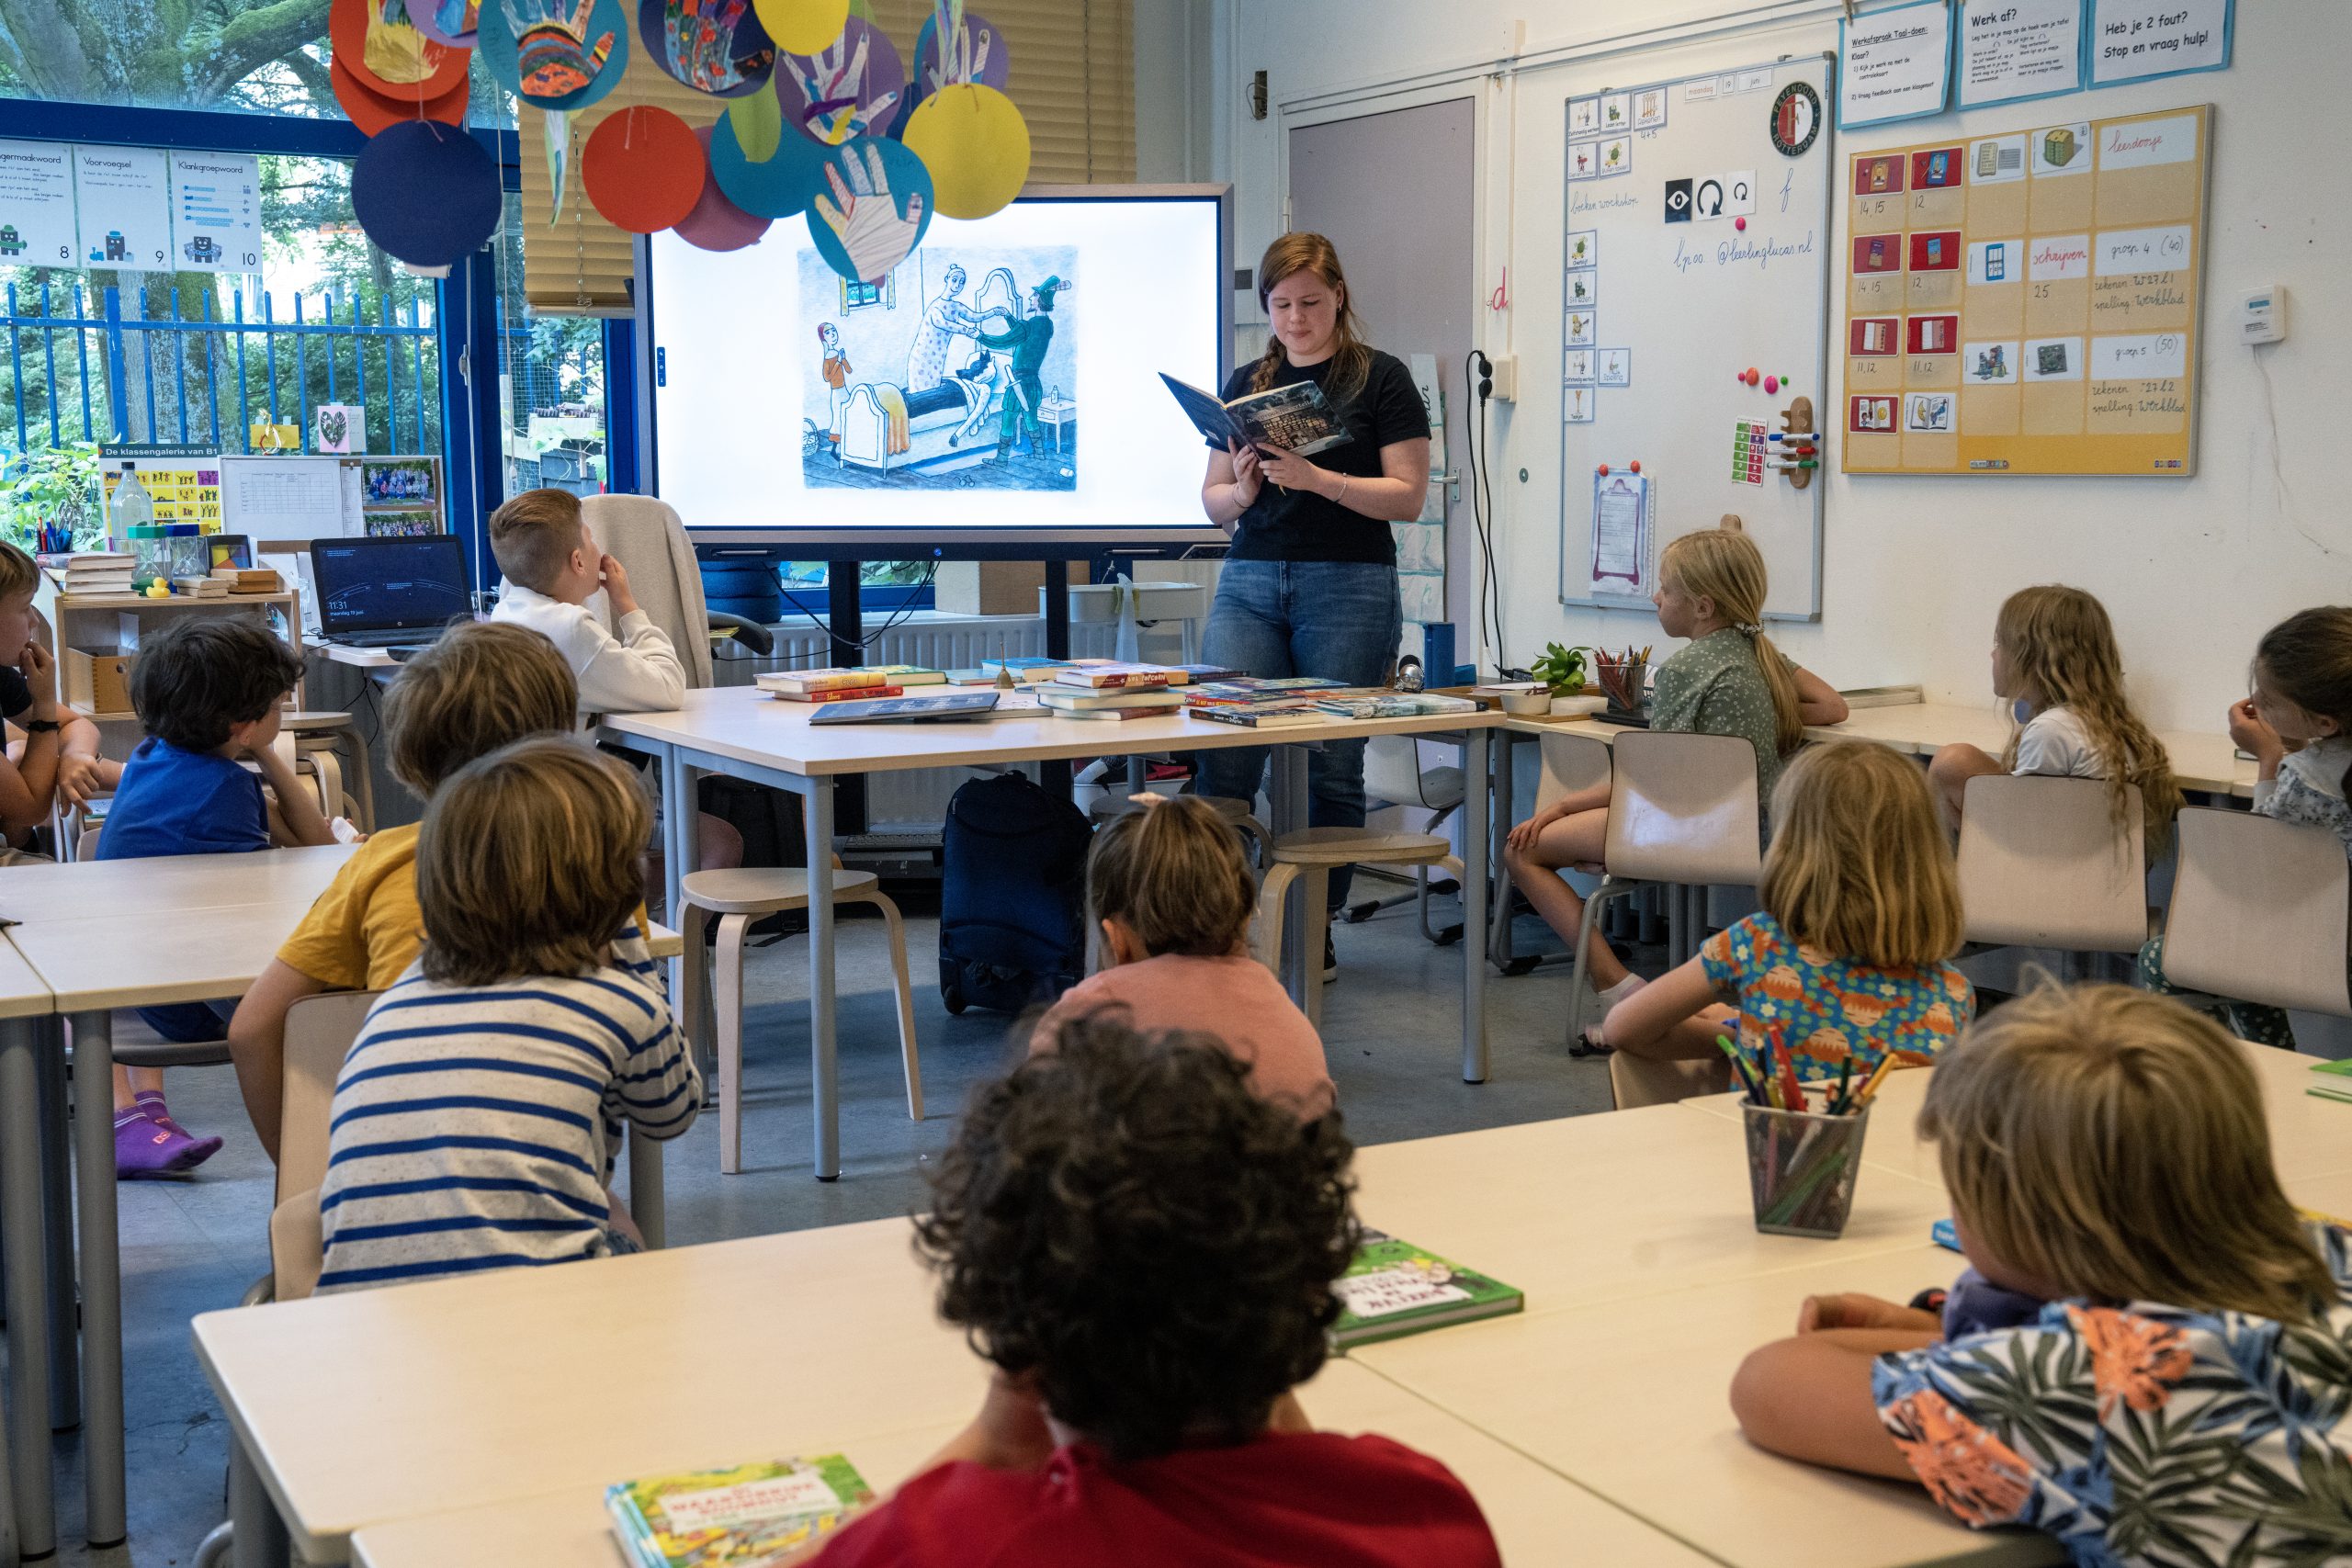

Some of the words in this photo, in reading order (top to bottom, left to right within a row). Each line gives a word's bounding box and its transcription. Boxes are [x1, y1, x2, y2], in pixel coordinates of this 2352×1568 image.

[1971, 12, 1997, 28] Werk
[2000, 8, 2017, 22] af?
[2105, 22, 2127, 36] Heb
[2131, 19, 2143, 35] je
[2147, 17, 2154, 28] 2
[2158, 10, 2188, 28] fout?
[2104, 46, 2129, 59] Stop
[2132, 43, 2145, 53] en
[2149, 39, 2179, 51] vraag
[2183, 29, 2209, 47] hulp!
[1851, 51, 1870, 61] Klaar?
[1773, 83, 1817, 113] FEYENOORD
[1785, 100, 1804, 139] F
[1772, 125, 1818, 155] ROTTERDAM
[0, 153, 62, 164] germaakwoord
[83, 156, 131, 171] Voorvoegsel
[178, 161, 243, 175] Klankgroepwoord
[1915, 195, 1926, 209] 12
[60, 245, 70, 259] 8
[2111, 244, 2139, 260] groep
[2143, 243, 2150, 254] 4
[2161, 234, 2184, 256] (40)
[155, 250, 164, 263] 9
[243, 253, 256, 265] 10
[2033, 246, 2087, 271] schrijven
[1912, 276, 1922, 288] 12
[2034, 284, 2051, 299] 25
[2141, 346, 2147, 355] 5
[2155, 334, 2178, 356] (50)
[120, 448, 185, 457] klassengalerie
[329, 601, 347, 610] 11:31
